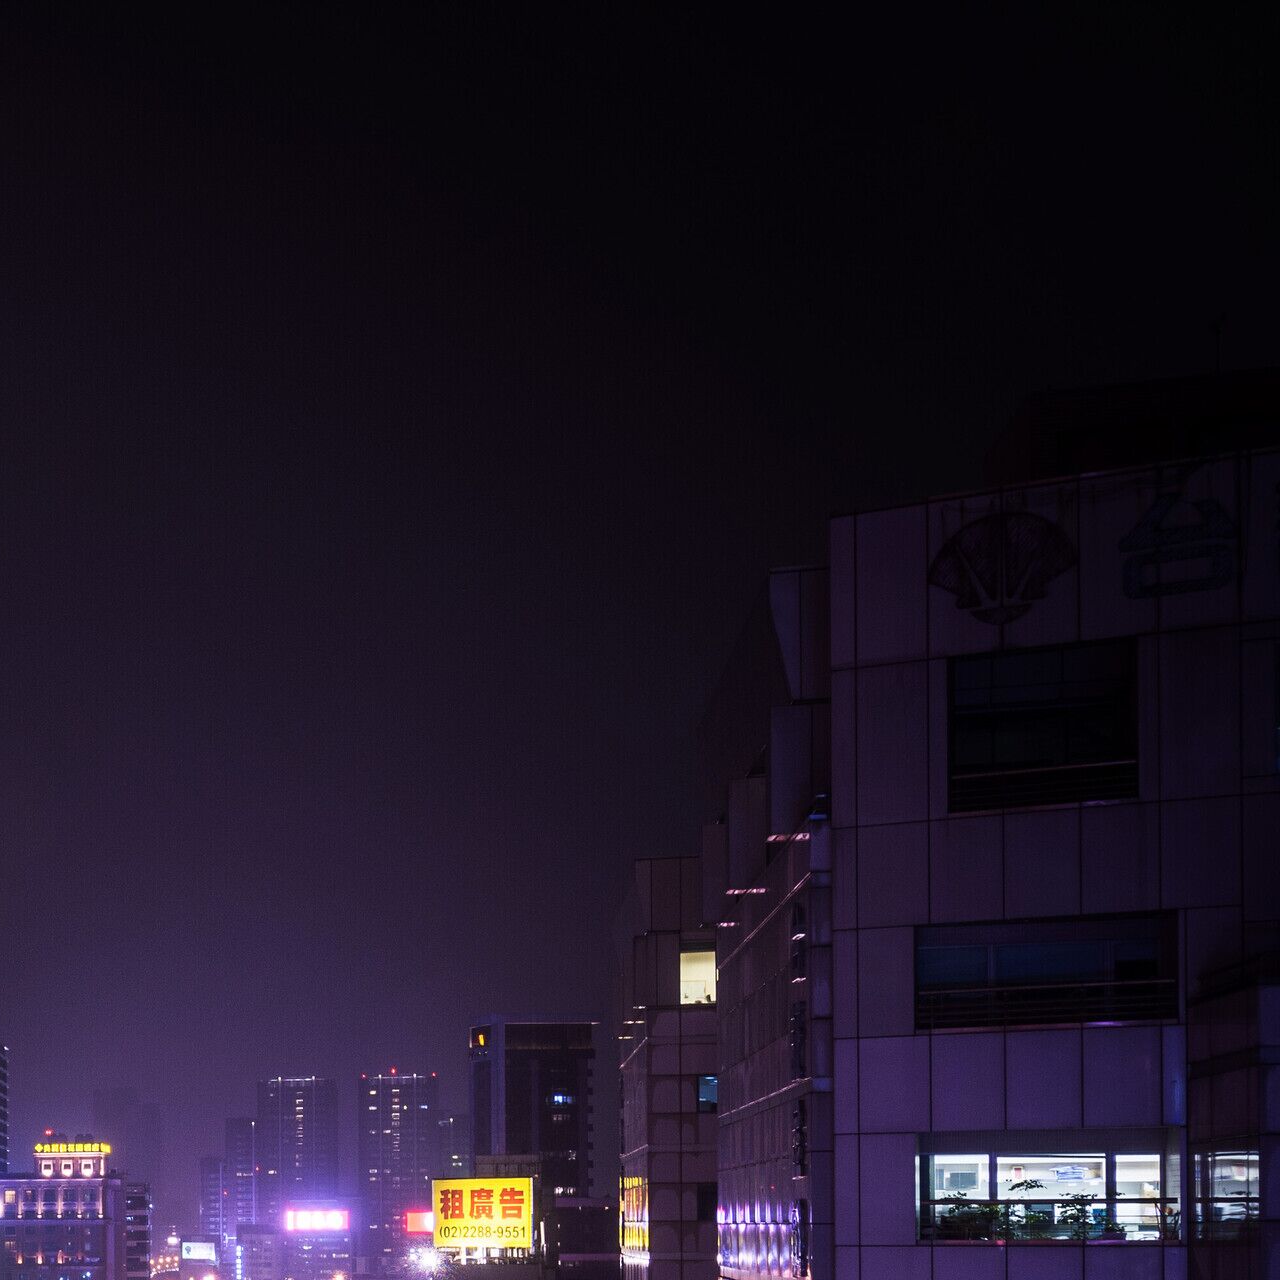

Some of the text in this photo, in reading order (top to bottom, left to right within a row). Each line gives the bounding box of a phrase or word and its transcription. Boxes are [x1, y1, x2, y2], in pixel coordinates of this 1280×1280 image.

[439, 1187, 525, 1220] 租廣告
[439, 1226, 527, 1239] (02)2288-9551
